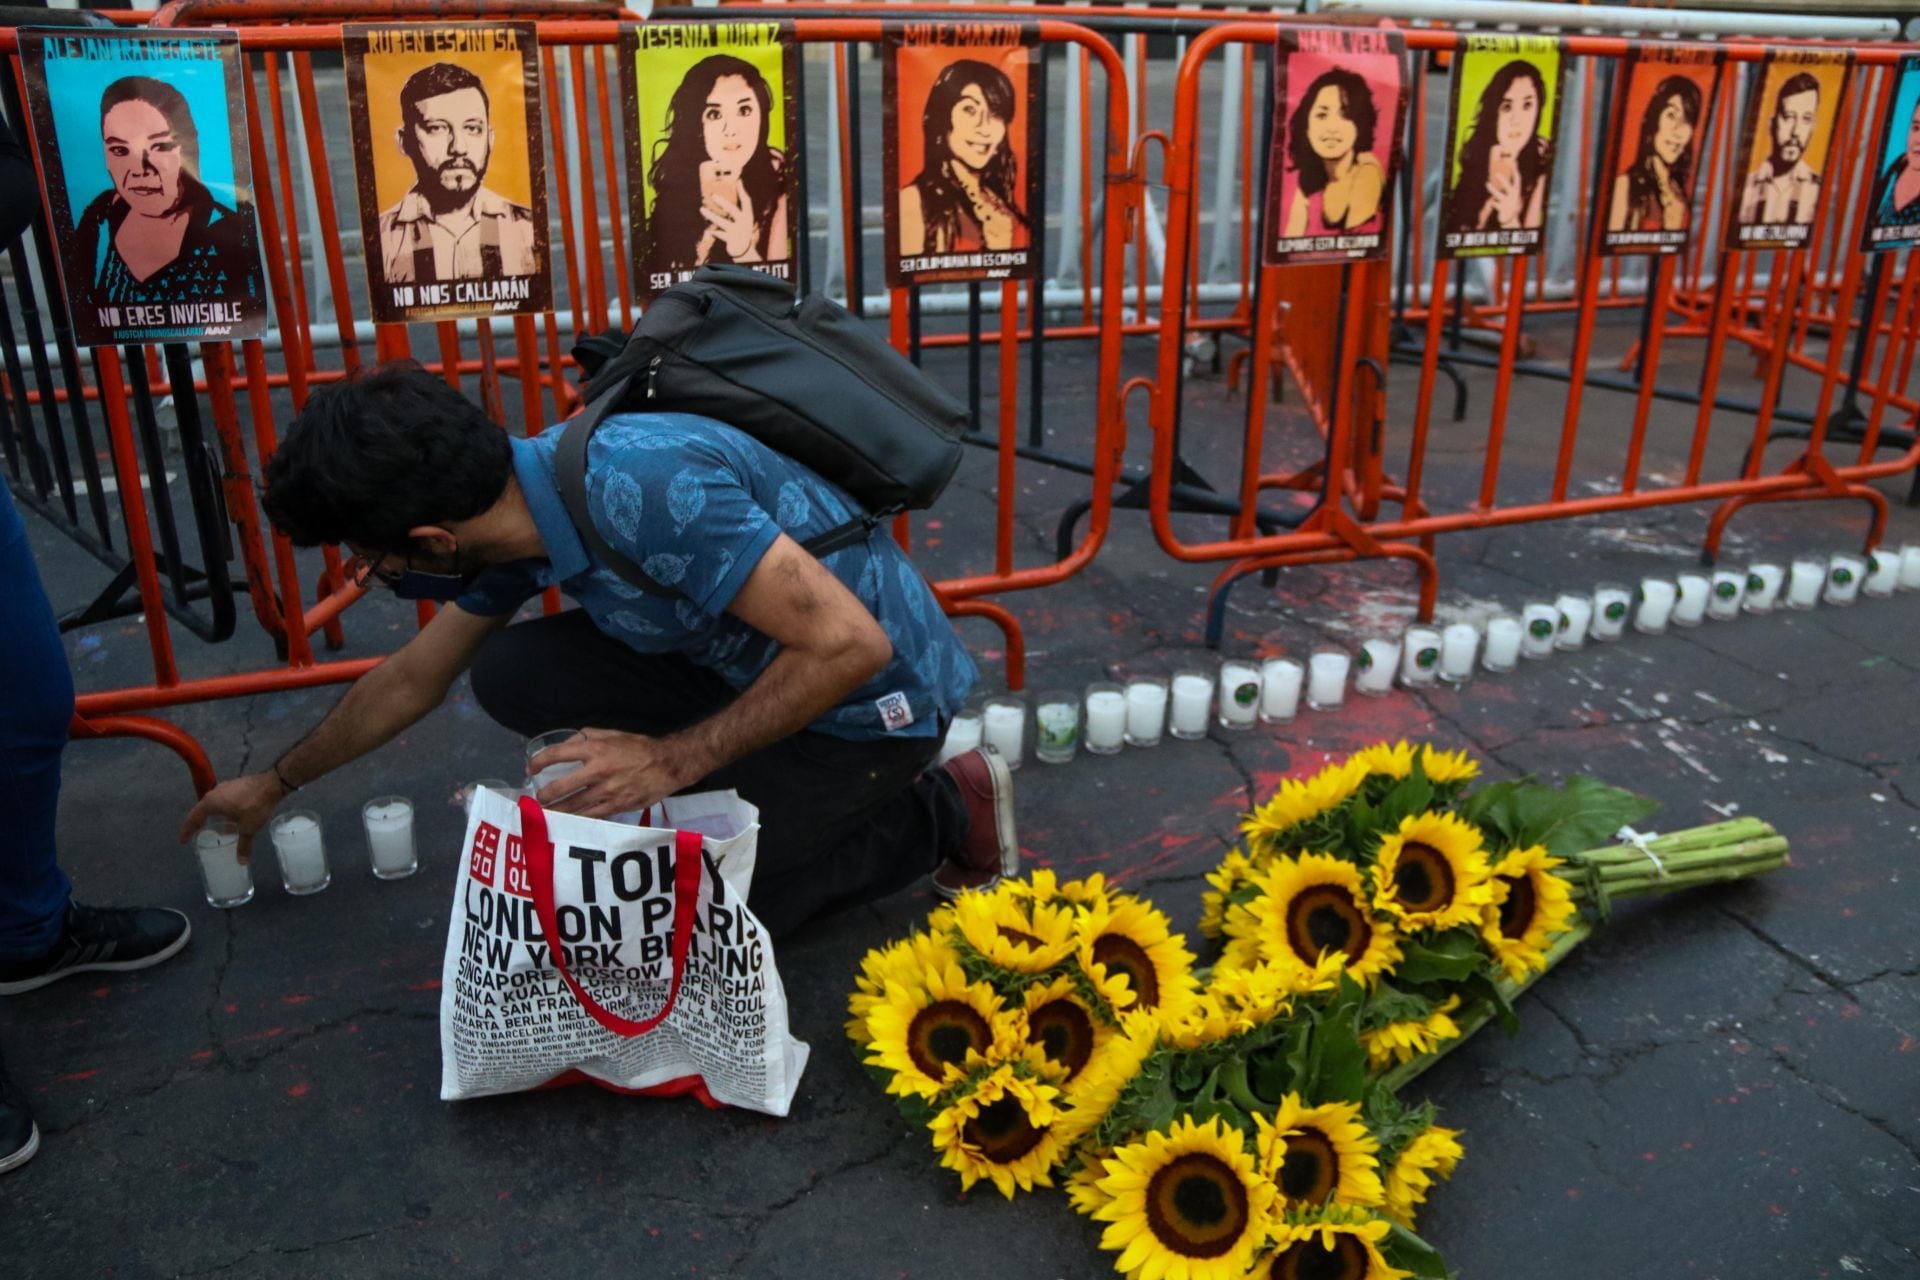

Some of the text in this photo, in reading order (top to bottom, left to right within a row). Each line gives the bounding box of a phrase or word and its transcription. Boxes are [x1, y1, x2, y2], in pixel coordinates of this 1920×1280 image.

[367, 28, 518, 53] RUBEN ESPINOSA
[635, 23, 711, 49] YESENIA
[393, 276, 529, 307] NO NOS CALLARÁN
[650, 272, 671, 289] SER
[98, 302, 243, 327] NO ERES INVISIBLE
[509, 866, 531, 892] QL
[465, 878, 622, 943] LONDON
[462, 921, 513, 973] NEW
[525, 943, 624, 969] YORK
[458, 956, 765, 998] SINGAPORE MOSCOW HANGHAI
[454, 994, 495, 1019] MANILA
[500, 1001, 532, 1018] SAN
[536, 985, 622, 1012] FRANISCO
[677, 986, 706, 1006] ONG
[710, 999, 766, 1027] BANGKOK
[455, 977, 496, 1006] OSAKA
[503, 980, 571, 1003] KUALA
[663, 975, 713, 997] TIPEI
[719, 992, 766, 1014] SEOUL
[452, 1010, 499, 1030] JAKARTA
[505, 1013, 552, 1029] BERLIN
[557, 996, 633, 1021] MELURNE
[637, 992, 684, 1006] SYDNY
[713, 1015, 767, 1039] ANTWERP
[452, 1022, 487, 1040] TORONTO
[490, 1025, 554, 1040] BARCELONA
[558, 1019, 600, 1033] UNIQLO.
[622, 1002, 651, 1016] TOKYO
[655, 1002, 690, 1019] LODON
[692, 1016, 717, 1034] PARIS
[480, 1038, 530, 1049] SINGAPORE
[533, 1033, 572, 1045] MOSCOW
[575, 1027, 613, 1040] SHANGH
[589, 1034, 619, 1046] BANGKO
